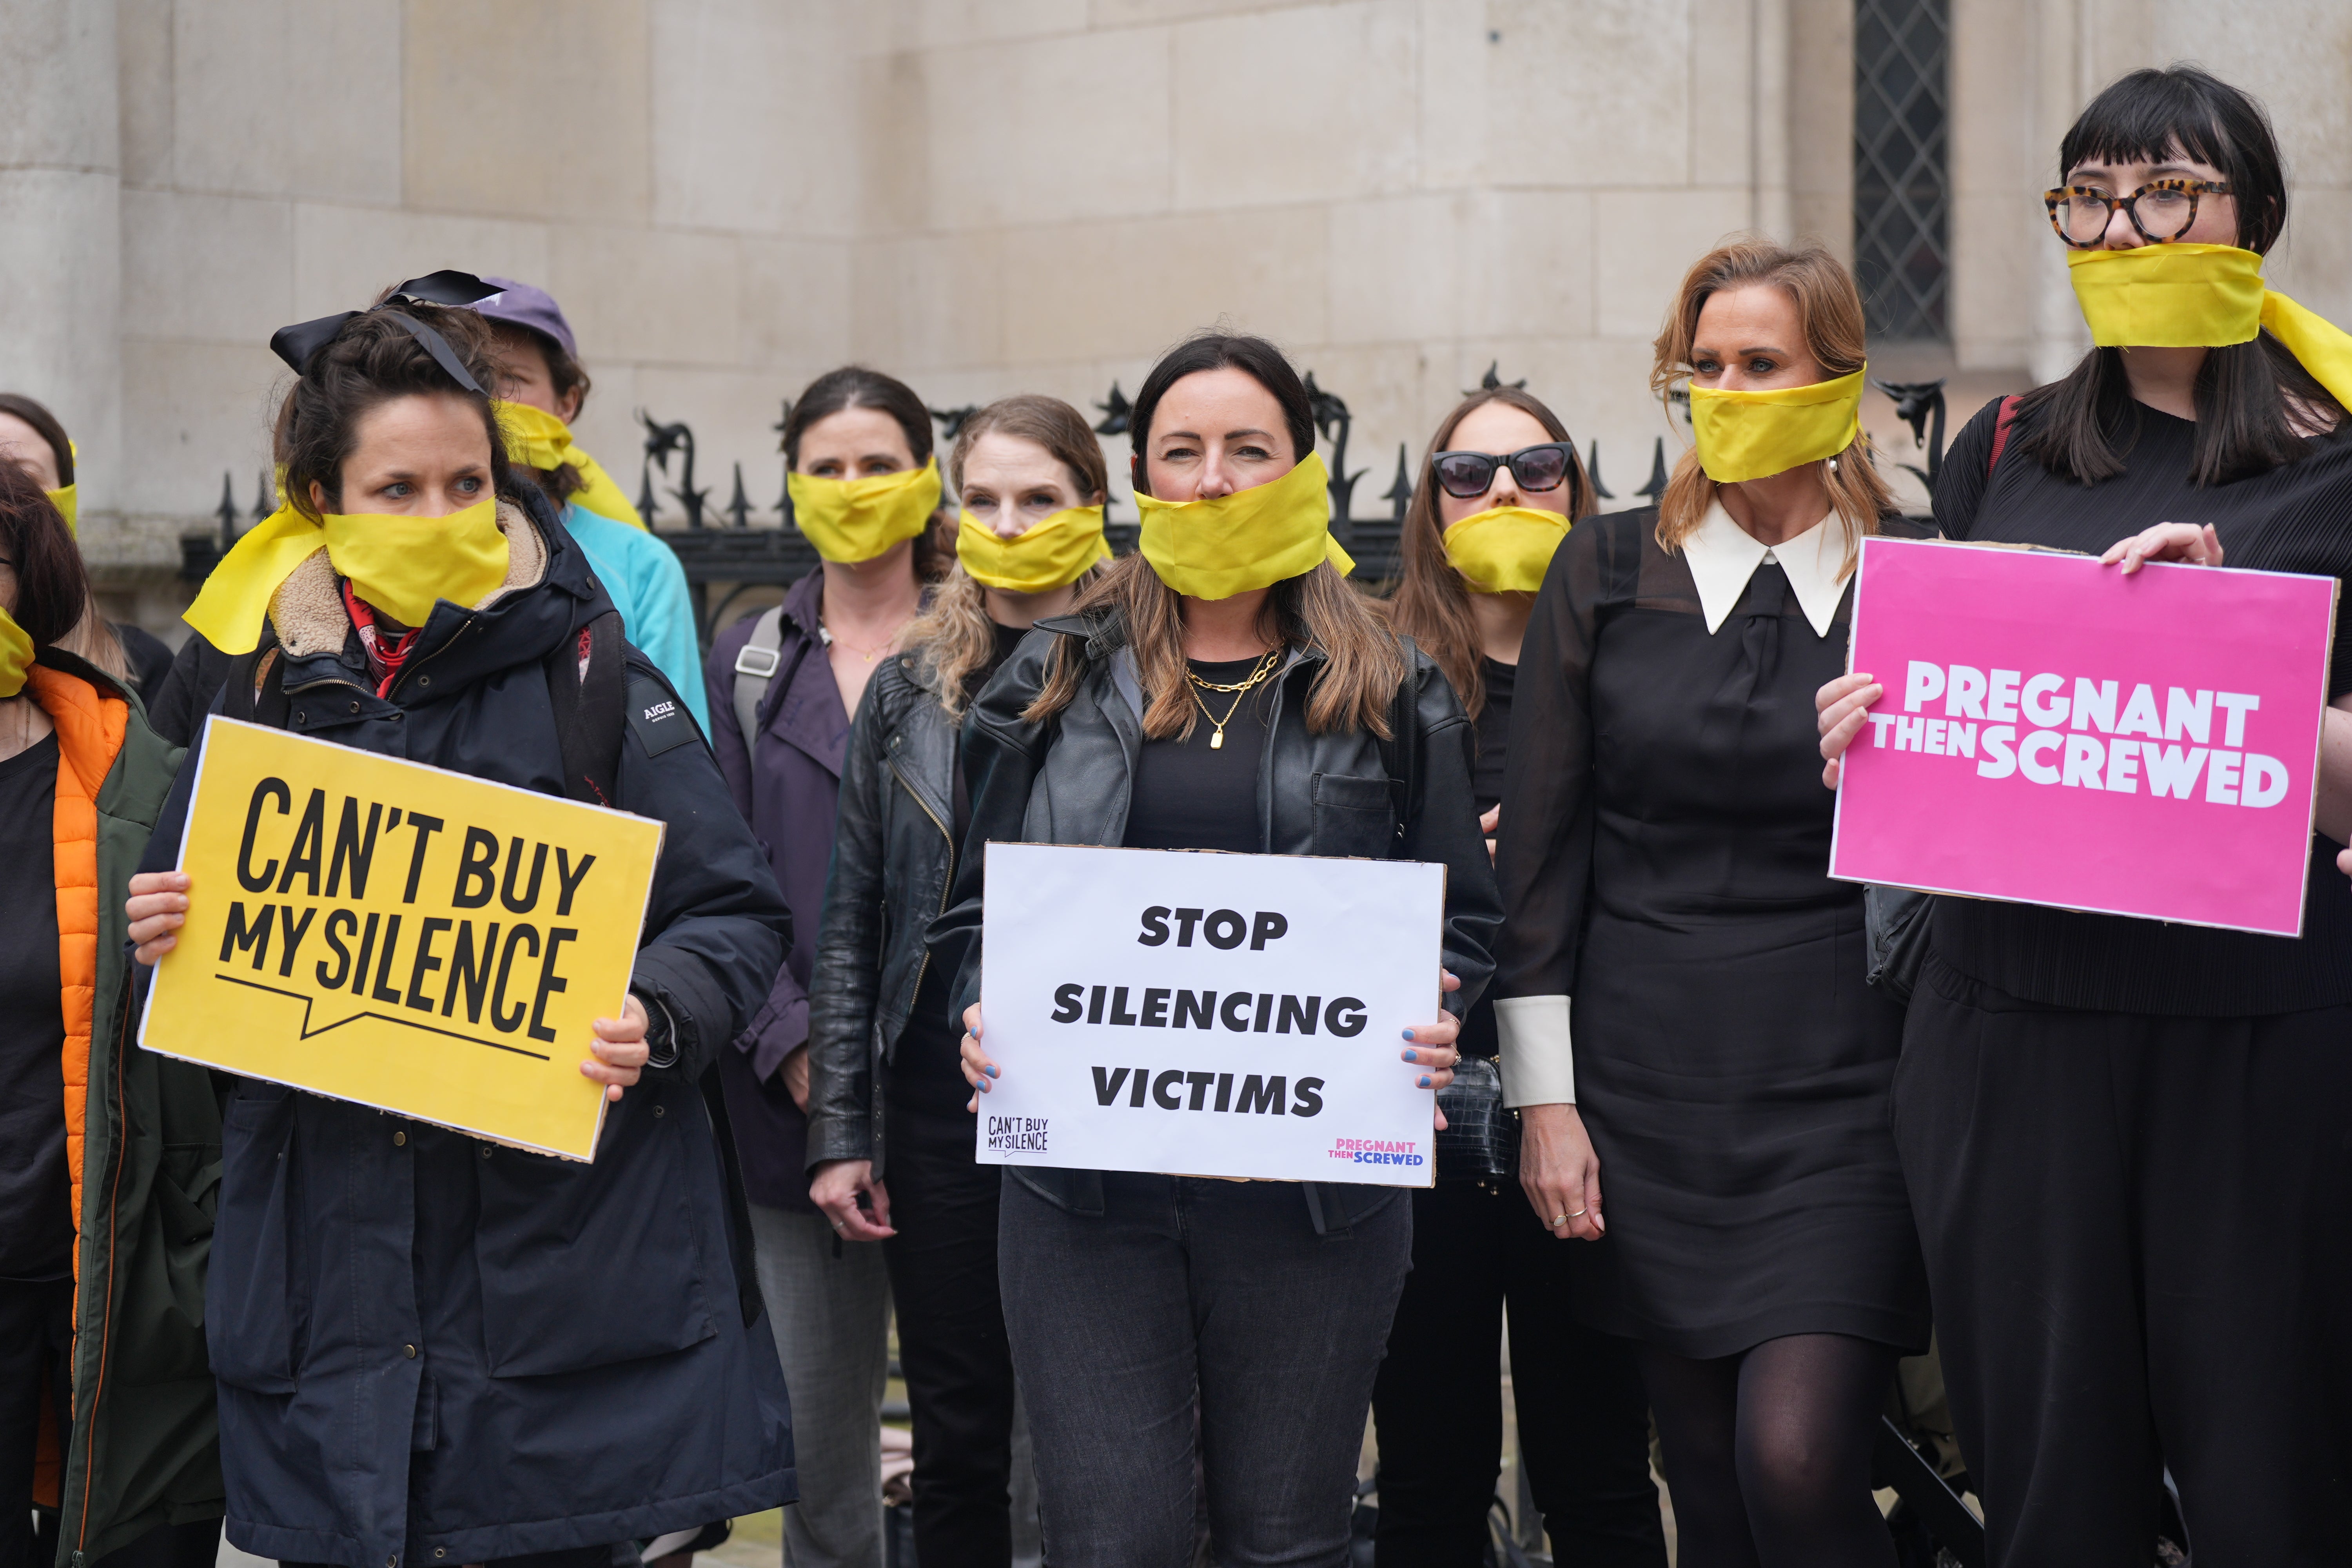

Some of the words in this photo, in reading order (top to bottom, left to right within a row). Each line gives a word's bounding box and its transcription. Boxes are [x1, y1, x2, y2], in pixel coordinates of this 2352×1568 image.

[644, 701, 675, 719] AIGLE
[1903, 660, 2261, 748] PREGNANT
[1868, 712, 1978, 759] THEN
[1976, 725, 2290, 808] SCREWED
[237, 777, 444, 904] CAN'T
[452, 826, 596, 916] BUY
[1137, 906, 1288, 951] STOP
[219, 901, 318, 978] MY
[316, 909, 578, 1043] SILENCE
[1051, 983, 1367, 1038] SILENCING
[1091, 1066, 1325, 1117] VICTIMS
[988, 1136, 1004, 1149] MY
[1005, 1131, 1048, 1151] SILENCE
[989, 1116, 1022, 1136] CAN'T
[1025, 1118, 1048, 1132] BUY
[1336, 1138, 1416, 1153] PREGNANT
[1328, 1150, 1354, 1159] THEN
[1354, 1151, 1423, 1166] SCREWED
